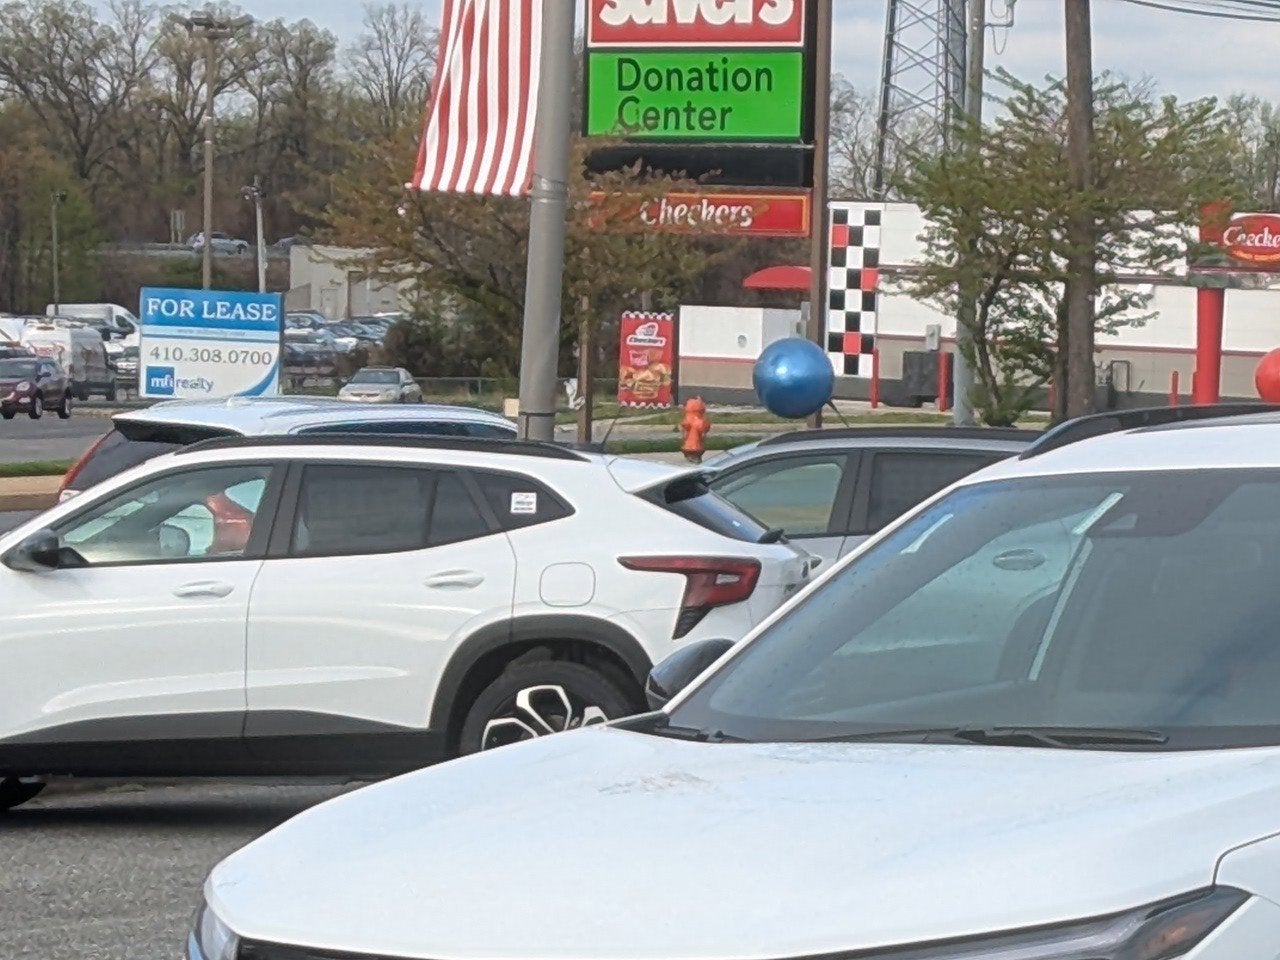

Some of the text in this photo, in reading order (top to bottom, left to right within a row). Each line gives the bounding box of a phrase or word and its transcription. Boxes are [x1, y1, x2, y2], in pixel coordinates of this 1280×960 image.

[617, 57, 773, 92] Donation
[617, 96, 733, 131] Center
[639, 197, 753, 227] Checkers
[147, 298, 277, 321] FOR LEASE
[150, 346, 272, 365] 410.308.0700
